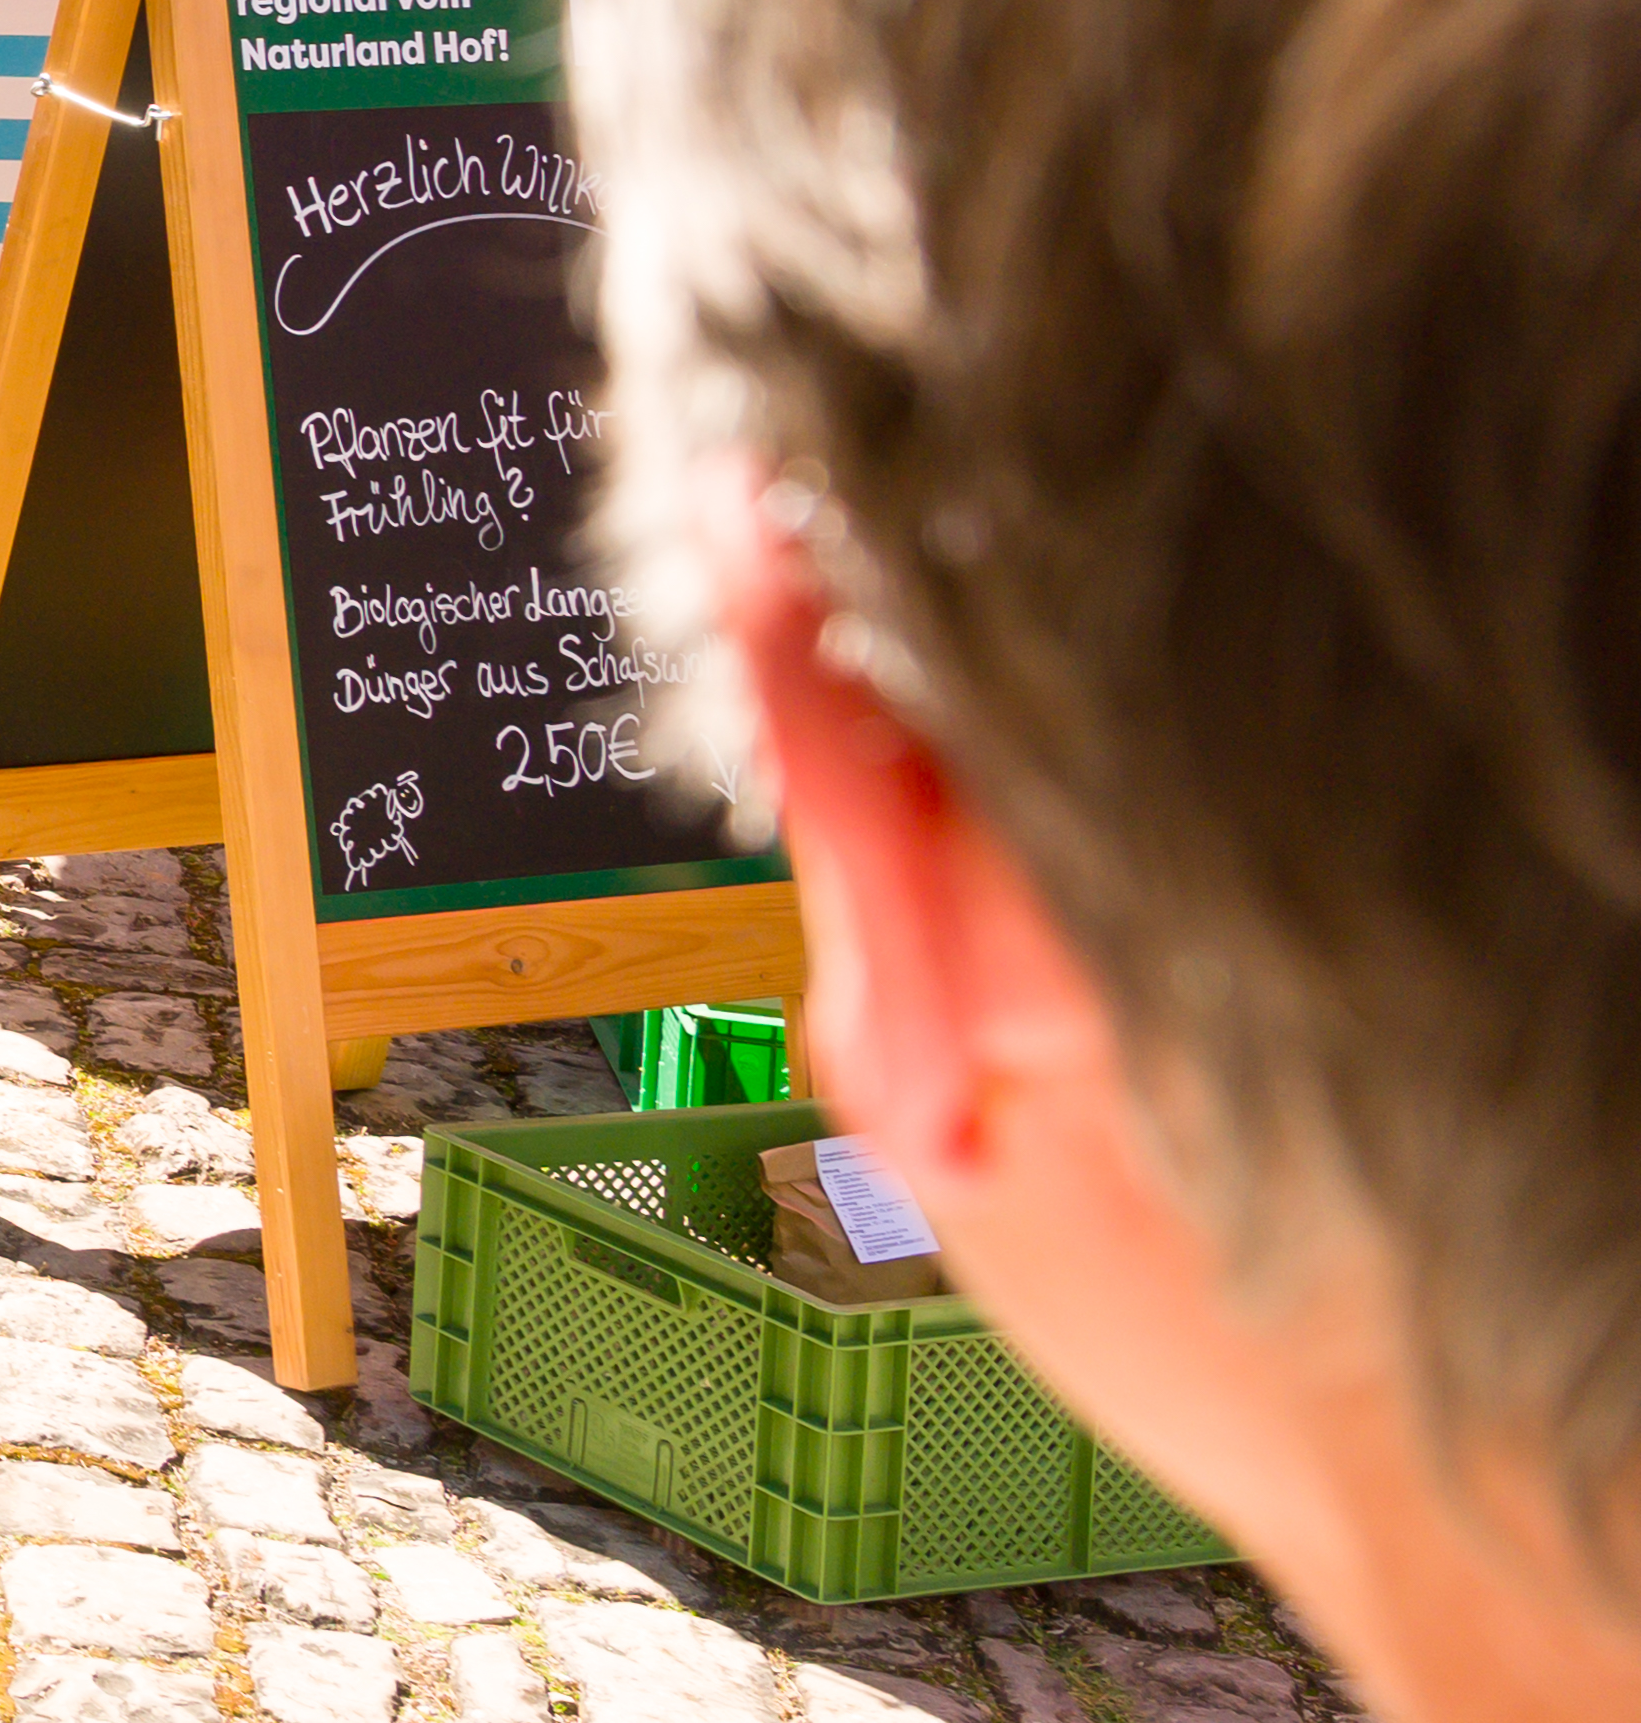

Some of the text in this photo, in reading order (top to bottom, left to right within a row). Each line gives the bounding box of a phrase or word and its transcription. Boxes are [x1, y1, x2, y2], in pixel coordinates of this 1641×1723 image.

[240, 29, 510, 71] Naturland Hof!
[285, 133, 490, 238] Herzlich
[300, 389, 617, 481] Pflanzen fit für
[329, 580, 520, 655] Biologischer
[333, 655, 457, 719] Dünger
[477, 662, 549, 698] aus
